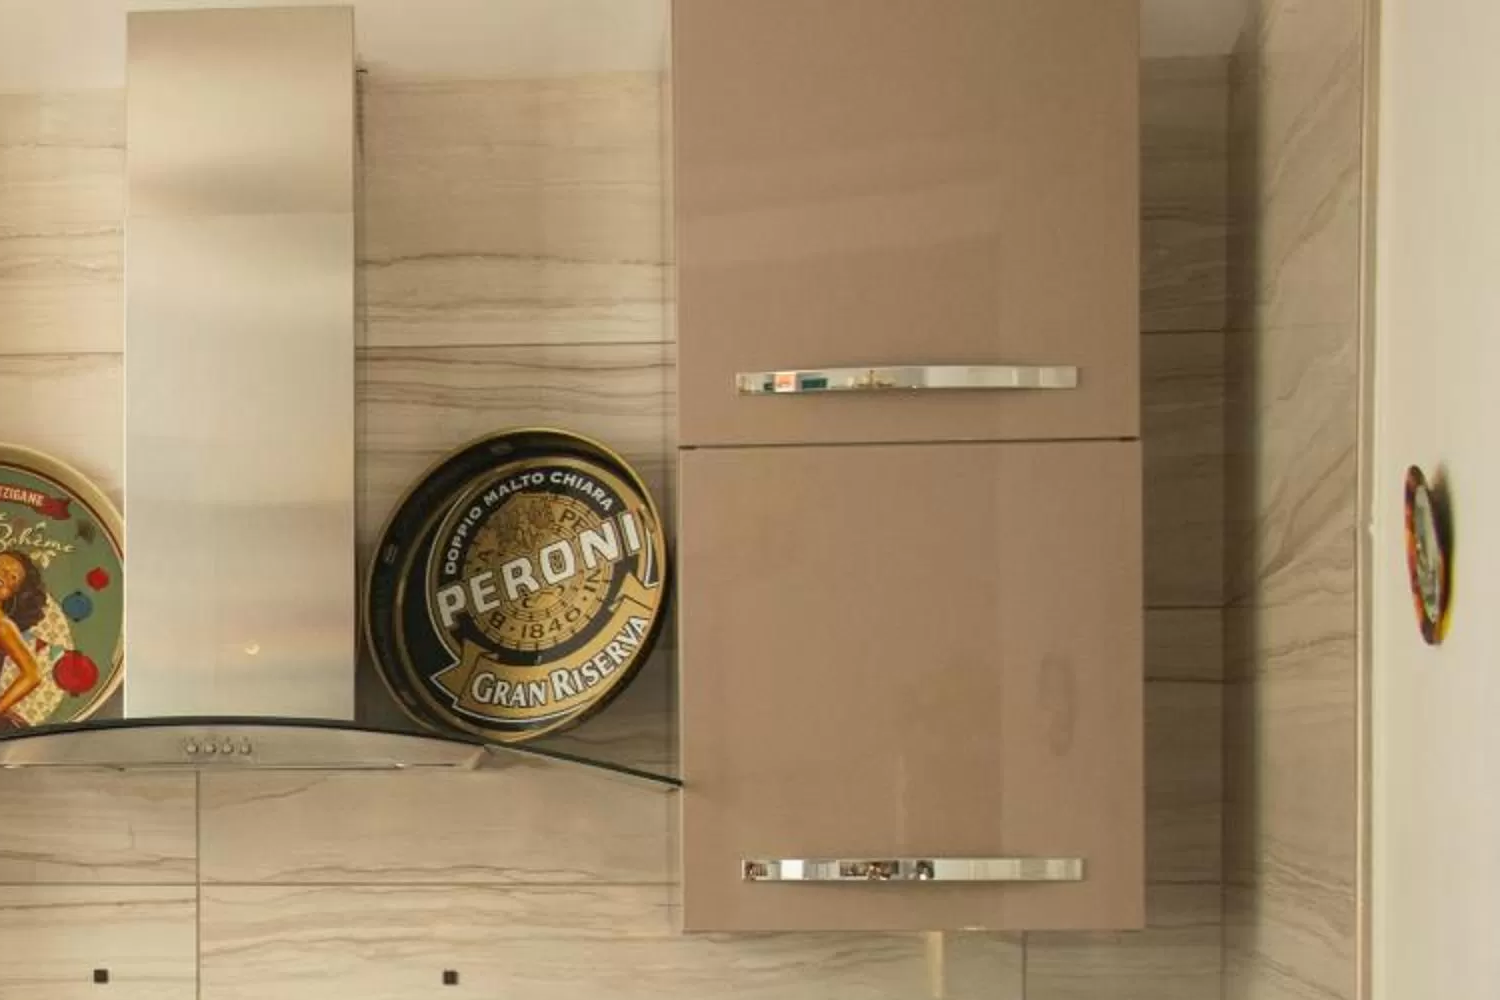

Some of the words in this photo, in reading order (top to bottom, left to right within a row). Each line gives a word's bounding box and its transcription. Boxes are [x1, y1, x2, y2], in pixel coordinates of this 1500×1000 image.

[436, 511, 642, 629] PERONI
[444, 506, 482, 575] DOPPIO
[483, 472, 545, 507] MALTO
[550, 471, 613, 511] CHIARA
[470, 671, 548, 708] GRAN
[549, 616, 651, 702] RISERVA
